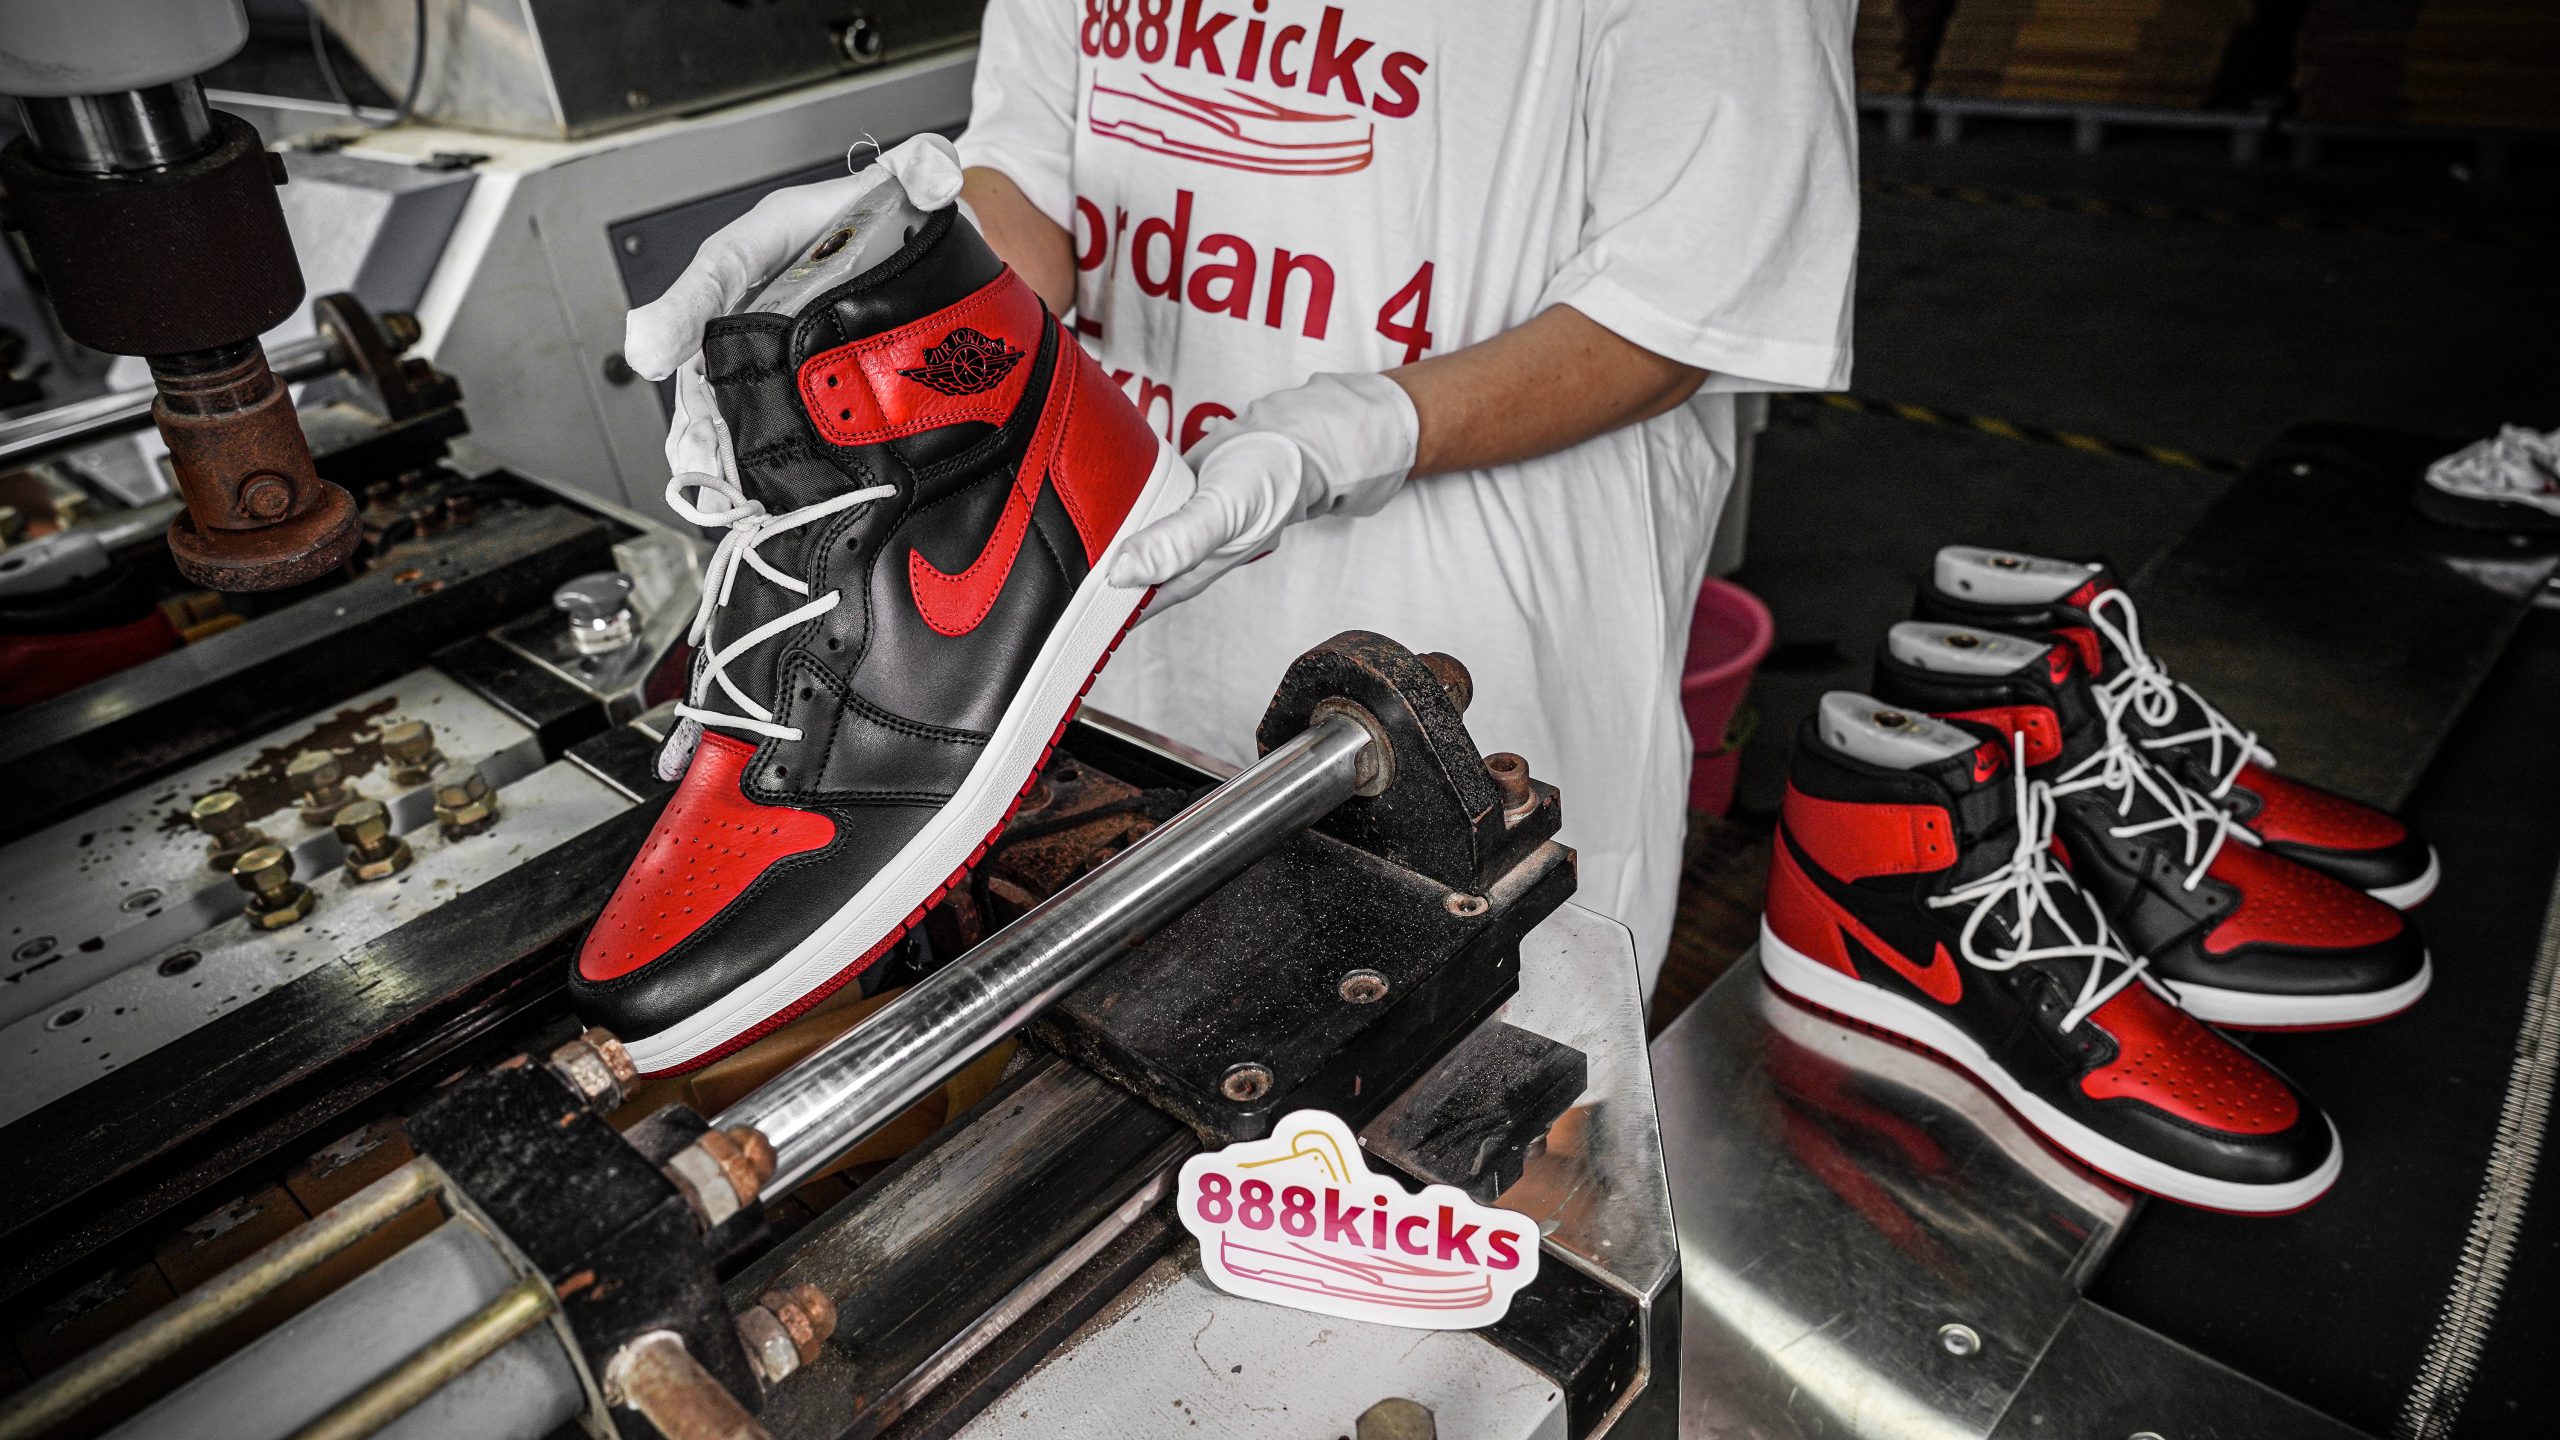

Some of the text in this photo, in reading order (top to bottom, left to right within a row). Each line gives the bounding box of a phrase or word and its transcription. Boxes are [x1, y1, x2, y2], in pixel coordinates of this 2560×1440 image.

[1076, 188, 1435, 366] ordan 4
[930, 342, 953, 363] AIR
[1196, 1172, 1520, 1271] 888kicks
